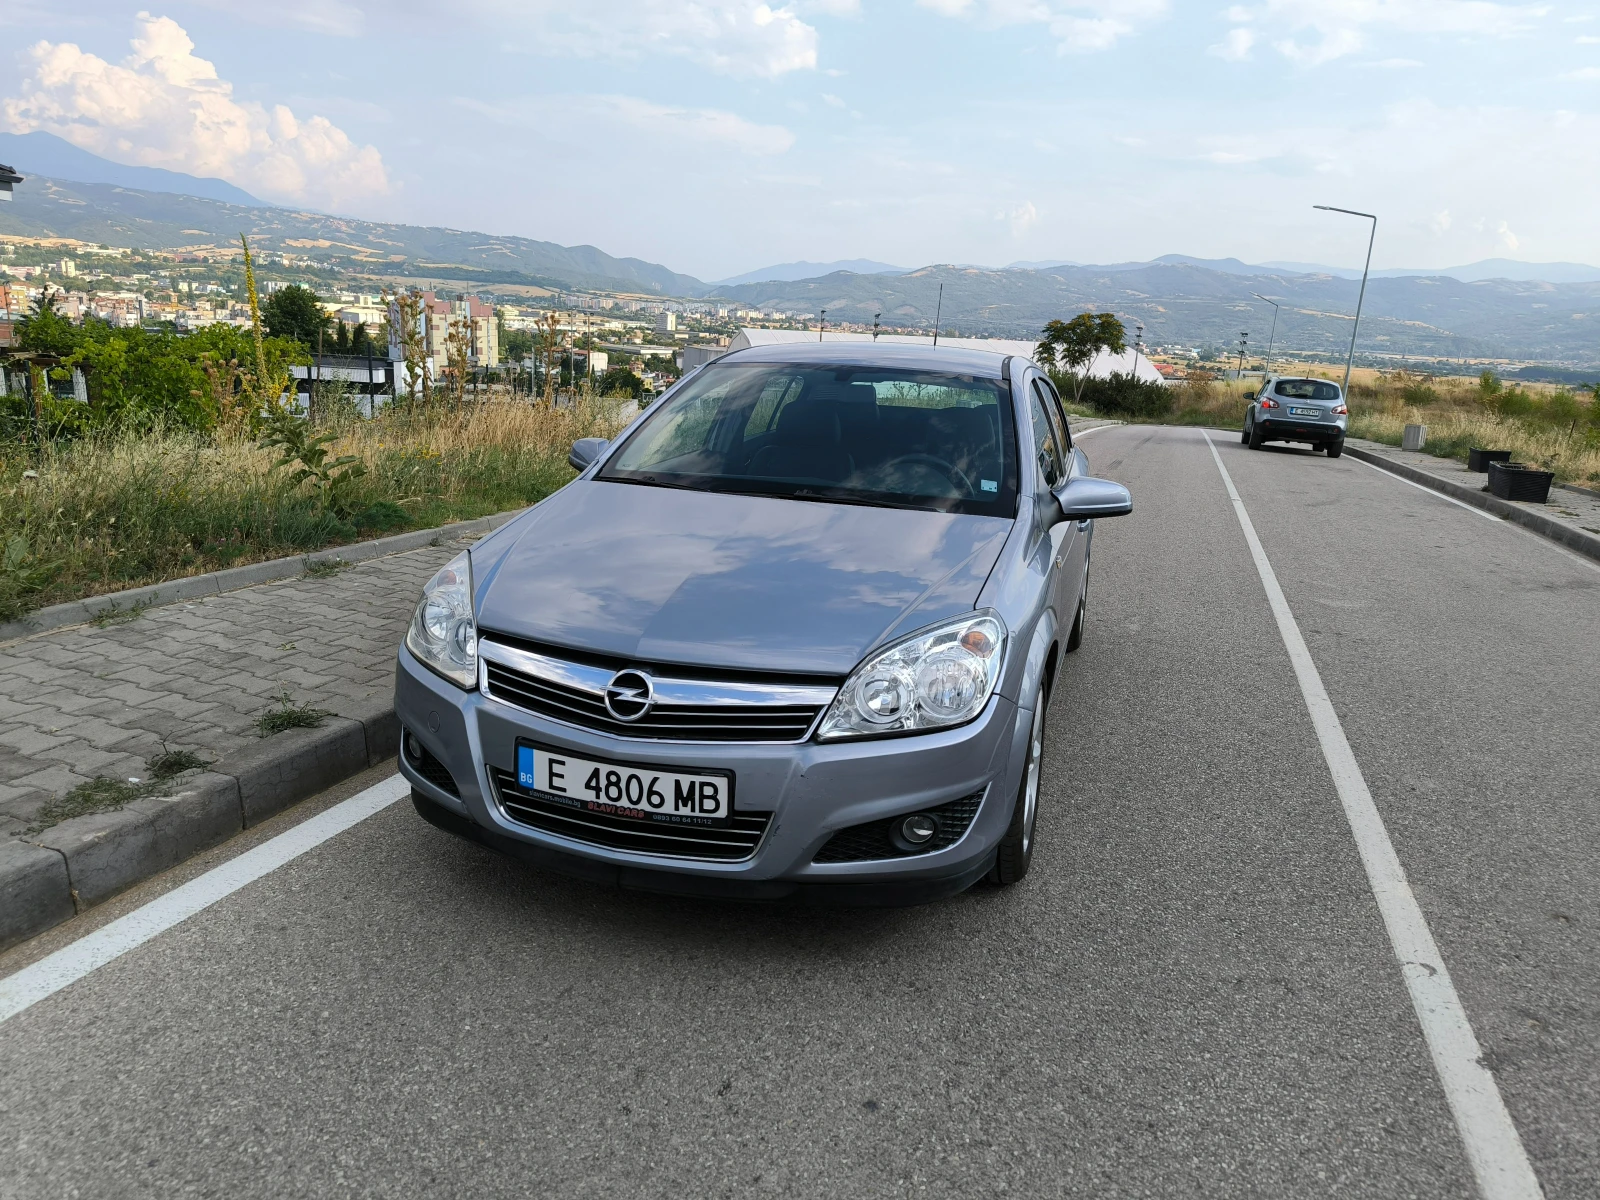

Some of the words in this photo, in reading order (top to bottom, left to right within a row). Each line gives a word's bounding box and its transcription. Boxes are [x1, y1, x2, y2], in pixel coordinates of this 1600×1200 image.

[520, 772, 533, 784] BG
[548, 757, 567, 793] E
[584, 767, 665, 809] 4806
[674, 779, 721, 814] MB
[587, 801, 616, 814] SLAVI
[617, 805, 645, 819] CARS
